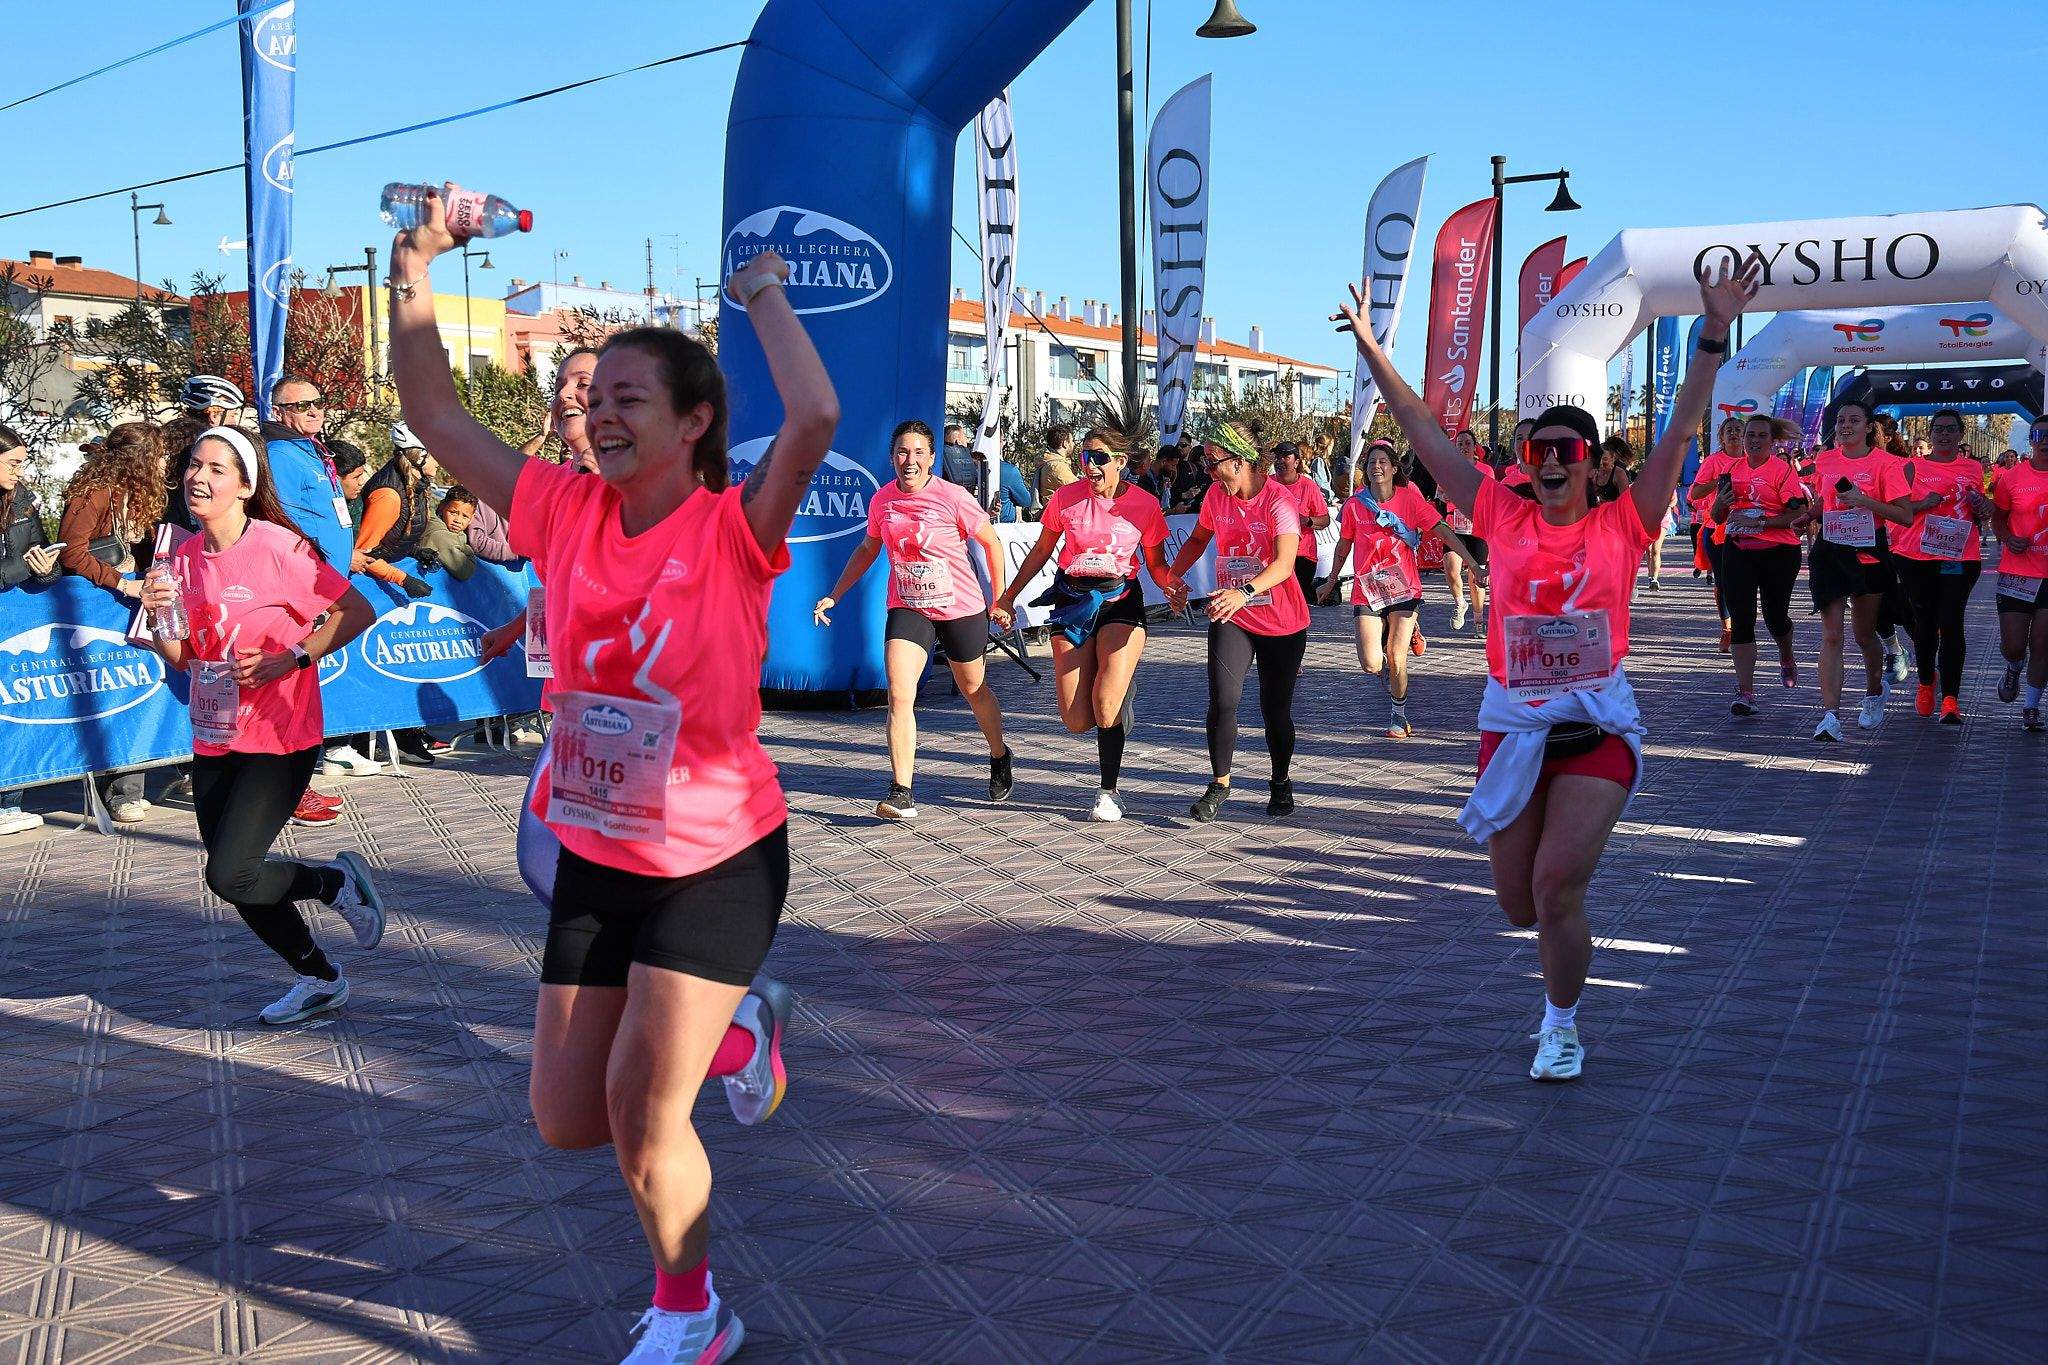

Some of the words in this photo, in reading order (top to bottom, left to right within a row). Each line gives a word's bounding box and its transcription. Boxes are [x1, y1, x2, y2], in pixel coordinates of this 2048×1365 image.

[464, 197, 473, 228] ZERO
[800, 244, 871, 258] LECHERA
[1693, 232, 1940, 289] OYSHO
[724, 249, 877, 290] ARIANA
[1447, 237, 1477, 360] Santander
[1556, 302, 1624, 318] OYSHO
[1832, 344, 1885, 354] TotalEnergies
[1938, 339, 1993, 350] TotalEnergies
[1655, 345, 1675, 415] Marlene
[1889, 377, 2005, 392] VOLVO
[1525, 393, 1586, 408] OYSHO
[915, 582, 936, 592] 016
[1379, 583, 1396, 593] 016
[391, 629, 434, 640] CENTRAL
[436, 626, 478, 637] LECHERA
[10, 657, 75, 673] CENTRAL
[81, 649, 140, 665] LECHERA
[1541, 652, 1580, 667] 016
[1519, 688, 1551, 698] OYSHO
[199, 697, 219, 712] 016
[584, 713, 628, 731] ASTURIANA
[582, 756, 625, 785] 016
[609, 820, 651, 834] Santander
